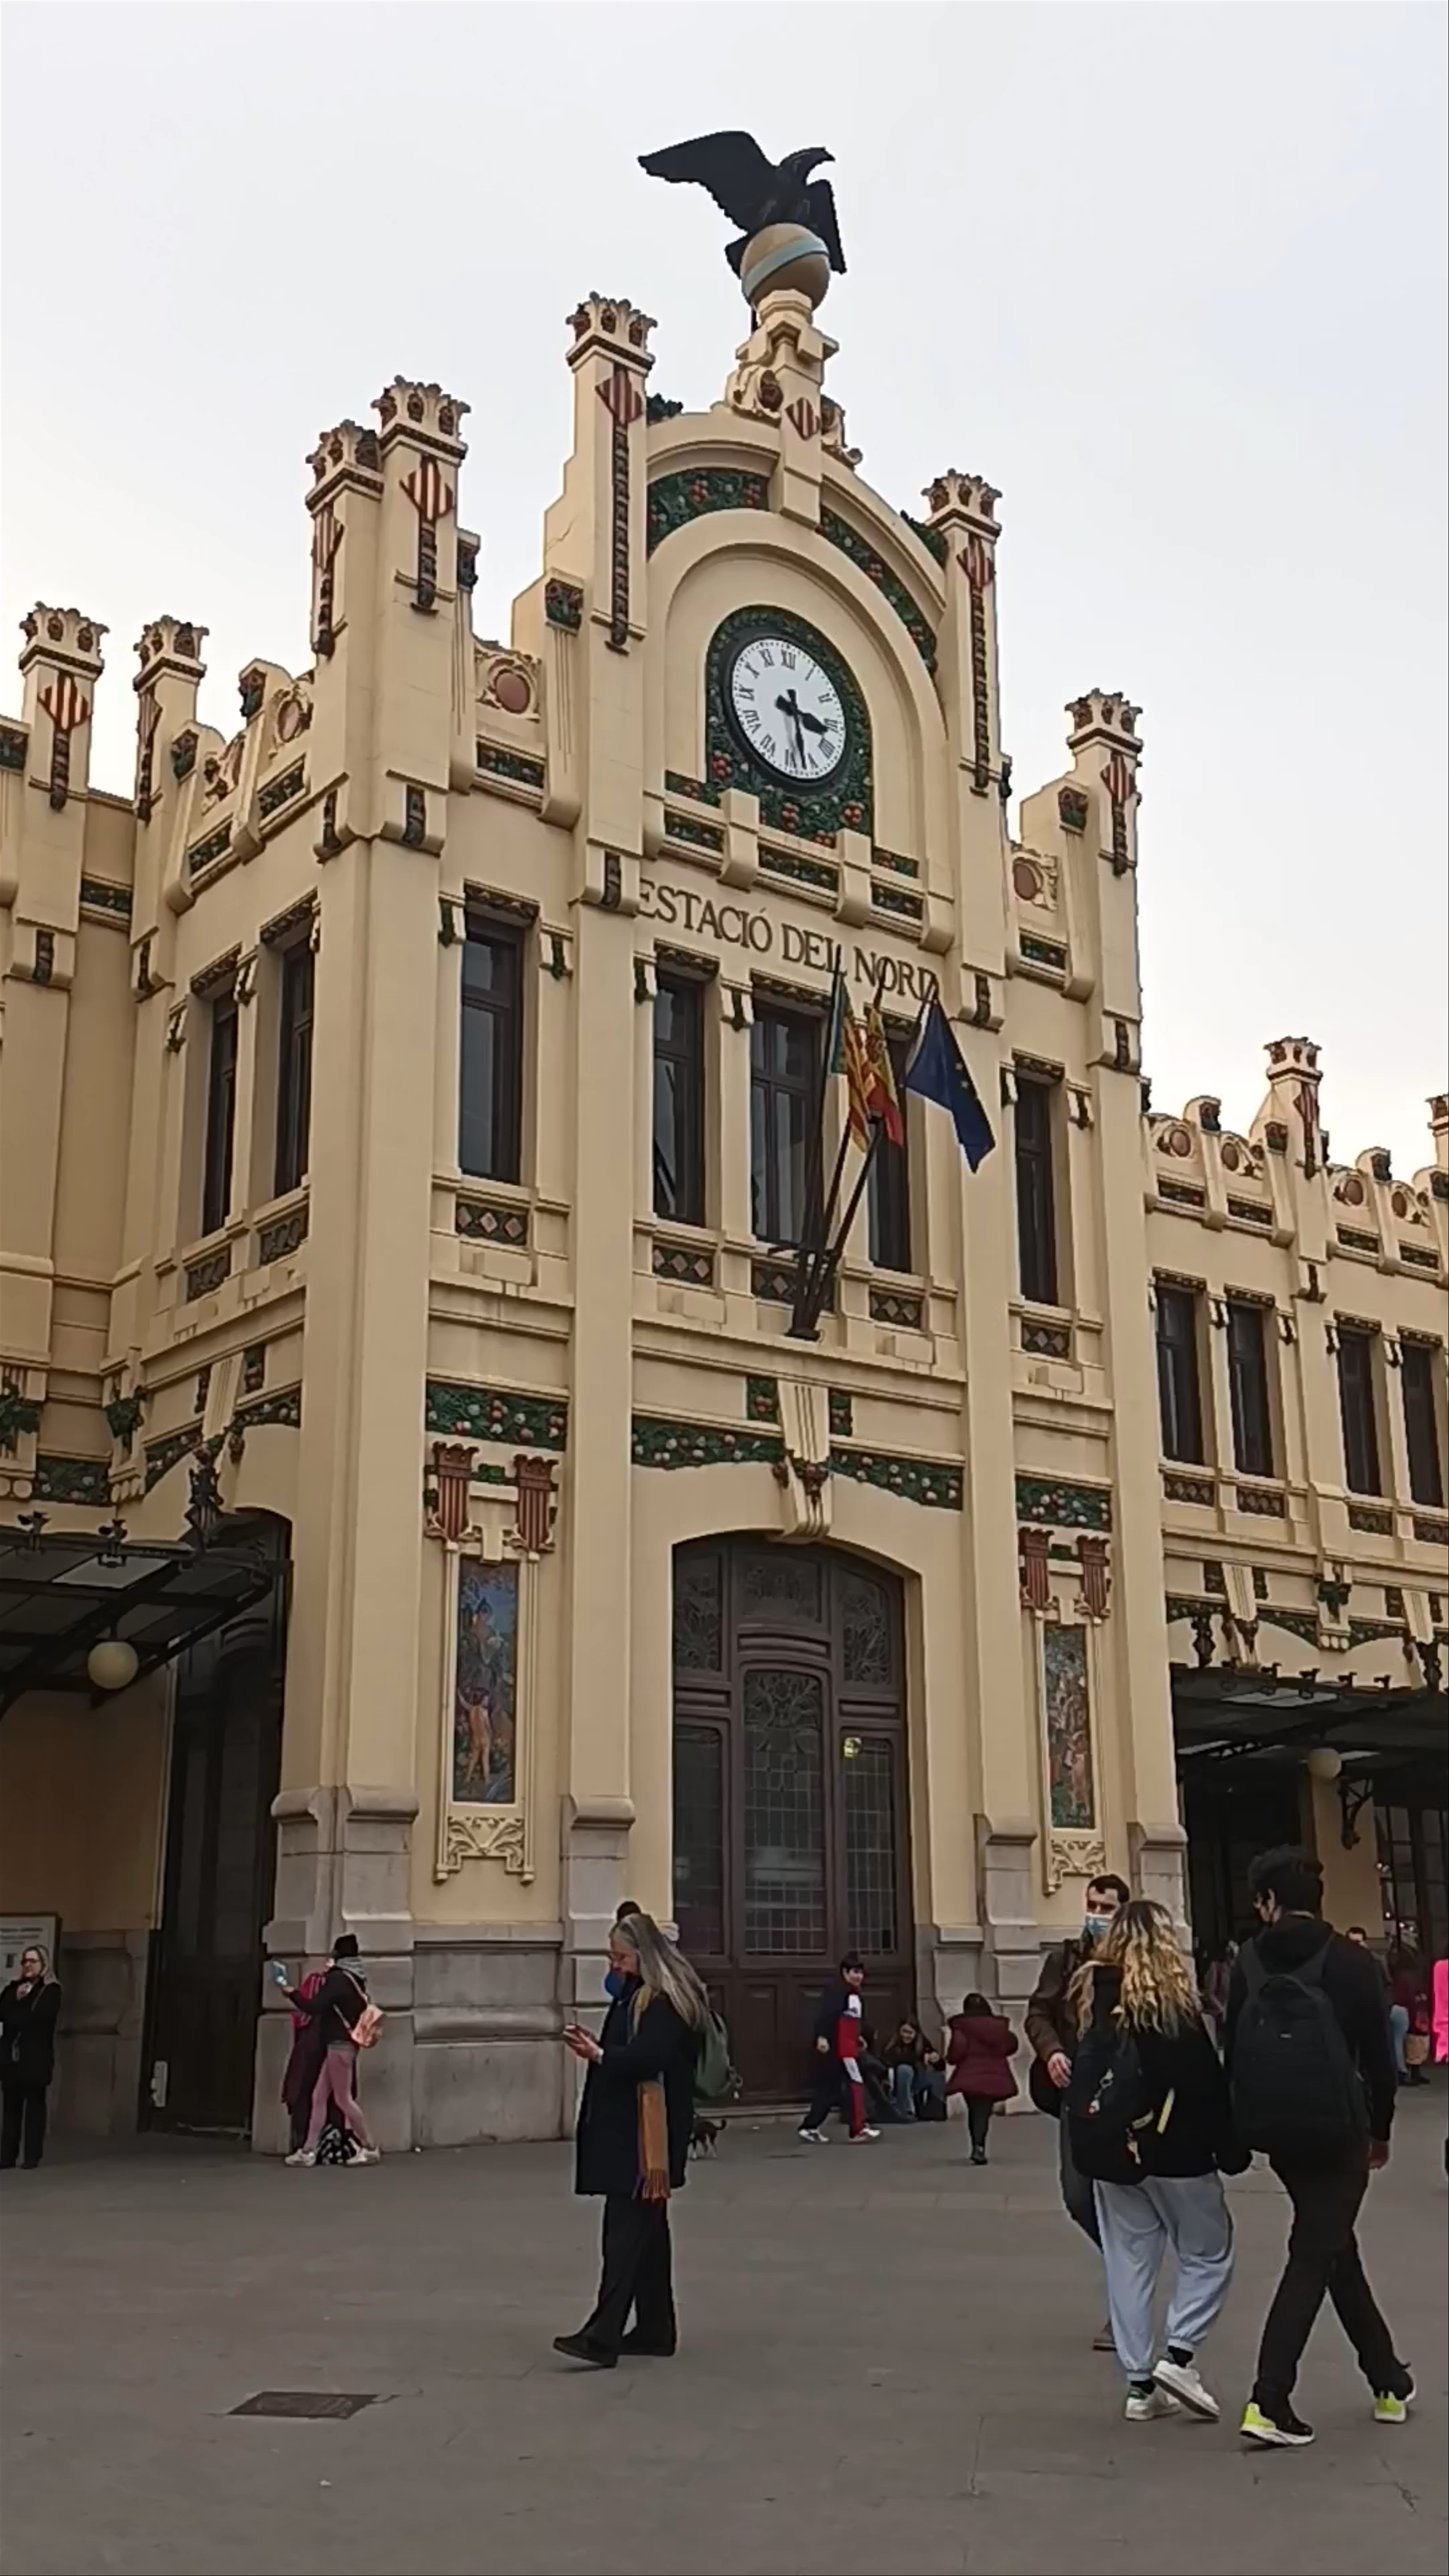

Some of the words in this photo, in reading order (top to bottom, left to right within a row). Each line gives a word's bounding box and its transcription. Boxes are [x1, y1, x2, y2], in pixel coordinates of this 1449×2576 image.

[638, 878, 772, 953] ESTACIÓ
[781, 923, 848, 977] DEL
[853, 946, 939, 1003] NORD
